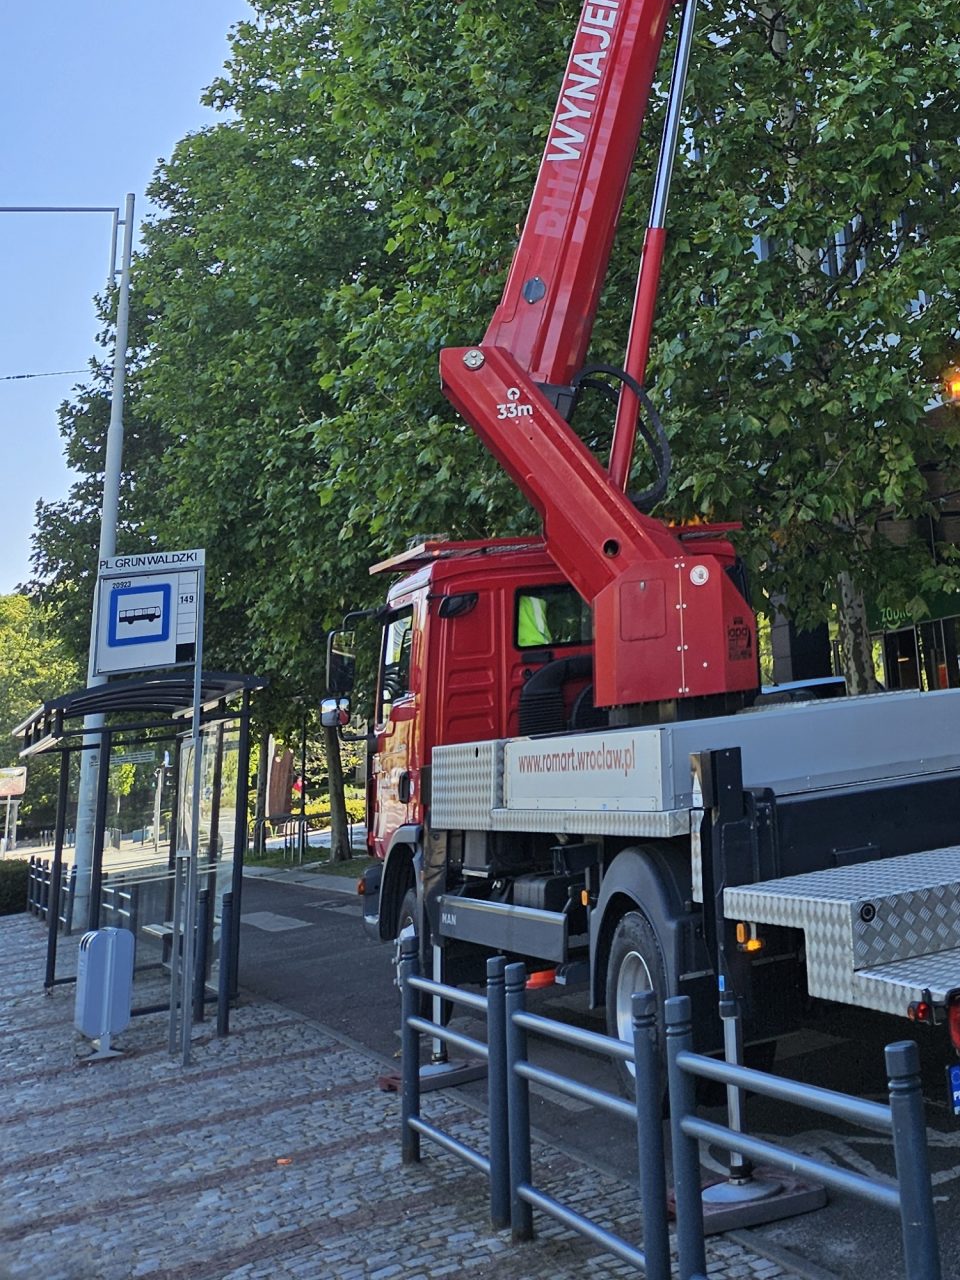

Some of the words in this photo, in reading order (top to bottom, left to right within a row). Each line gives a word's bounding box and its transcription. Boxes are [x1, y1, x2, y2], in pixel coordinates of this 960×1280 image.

[496, 403, 533, 420] 33m
[115, 552, 198, 568] GRUNWALDZKI
[180, 595, 194, 604] 149
[518, 740, 636, 777] www.romart.wroclaw.pl
[441, 912, 457, 926] MAN
